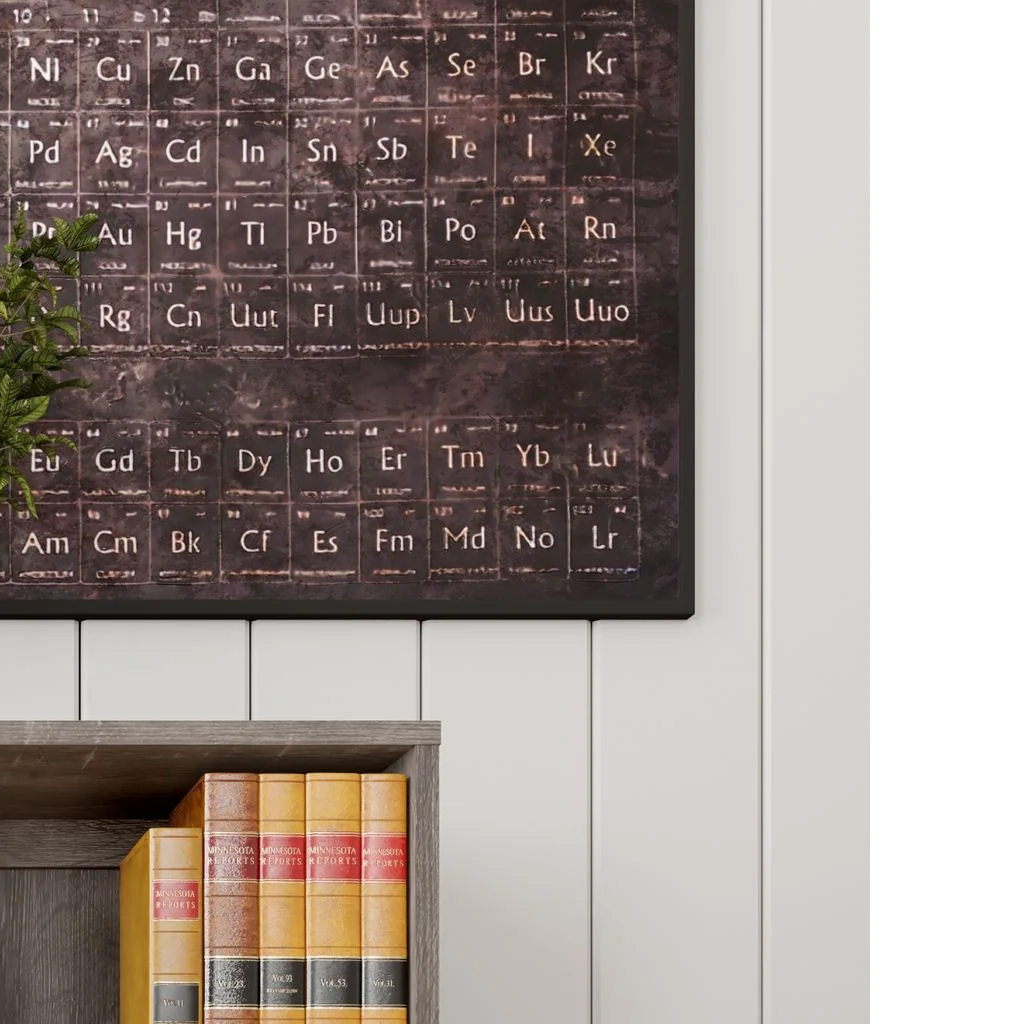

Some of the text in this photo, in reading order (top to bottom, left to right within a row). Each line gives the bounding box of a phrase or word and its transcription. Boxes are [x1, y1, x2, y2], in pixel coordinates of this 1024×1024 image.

[13, 9, 32, 23] 10
[83, 9, 99, 23] 11
[96, 57, 131, 81] Cu
[168, 57, 200, 81] Zn
[235, 57, 271, 81] Ga
[304, 56, 341, 80] Ge
[376, 55, 410, 79] As
[447, 52, 477, 77] Se
[518, 52, 547, 76] Br
[586, 51, 617, 75] Kr
[29, 140, 60, 164] Pd
[95, 141, 134, 168] Ag
[165, 139, 201, 163] Cd
[242, 139, 265, 163] In
[307, 138, 338, 163] Sn
[376, 137, 407, 161] Sb
[445, 135, 477, 159] Te
[527, 133, 533, 158] I
[583, 133, 617, 157] Xe
[98, 222, 133, 247] Au
[166, 221, 203, 250] Hg
[307, 220, 338, 245] Pb
[380, 220, 403, 243] Bi
[446, 218, 476, 242] Po
[584, 215, 617, 240] Rn
[100, 304, 131, 332] Rg
[167, 304, 202, 328] Cn
[230, 304, 279, 328] Uut
[366, 302, 421, 330] Uup
[448, 300, 476, 323] Lv
[505, 298, 554, 323] Uus
[575, 298, 630, 323] Uuo
[31, 449, 60, 473] Eu
[95, 449, 135, 473] Gd
[169, 448, 202, 472] Tb
[238, 449, 273, 477] Dy
[306, 449, 344, 473] Ho
[381, 446, 407, 471] Er
[441, 445, 485, 469] Tm
[516, 444, 550, 468] Yb
[587, 443, 618, 468] Lu
[21, 533, 70, 555] Am
[93, 530, 138, 554] Cm
[171, 530, 201, 553] Bk
[240, 530, 273, 553] Cf
[314, 530, 339, 554] Es
[376, 529, 414, 552] Fm
[444, 526, 487, 550] Md
[516, 526, 555, 549] No
[592, 525, 620, 549] Lr
[207, 845, 255, 855] MINNESOTA
[207, 857, 256, 866] REPORTS
[259, 857, 302, 866] REPORTS
[260, 846, 302, 856] MINNESOTA
[308, 846, 357, 856] MINNESOTA
[308, 857, 358, 866] REPORTS
[363, 847, 404, 857] MINNESOTA
[362, 859, 405, 868] REPORTS
[155, 890, 196, 899] MINNESOTA
[156, 901, 196, 909] REPORTS
